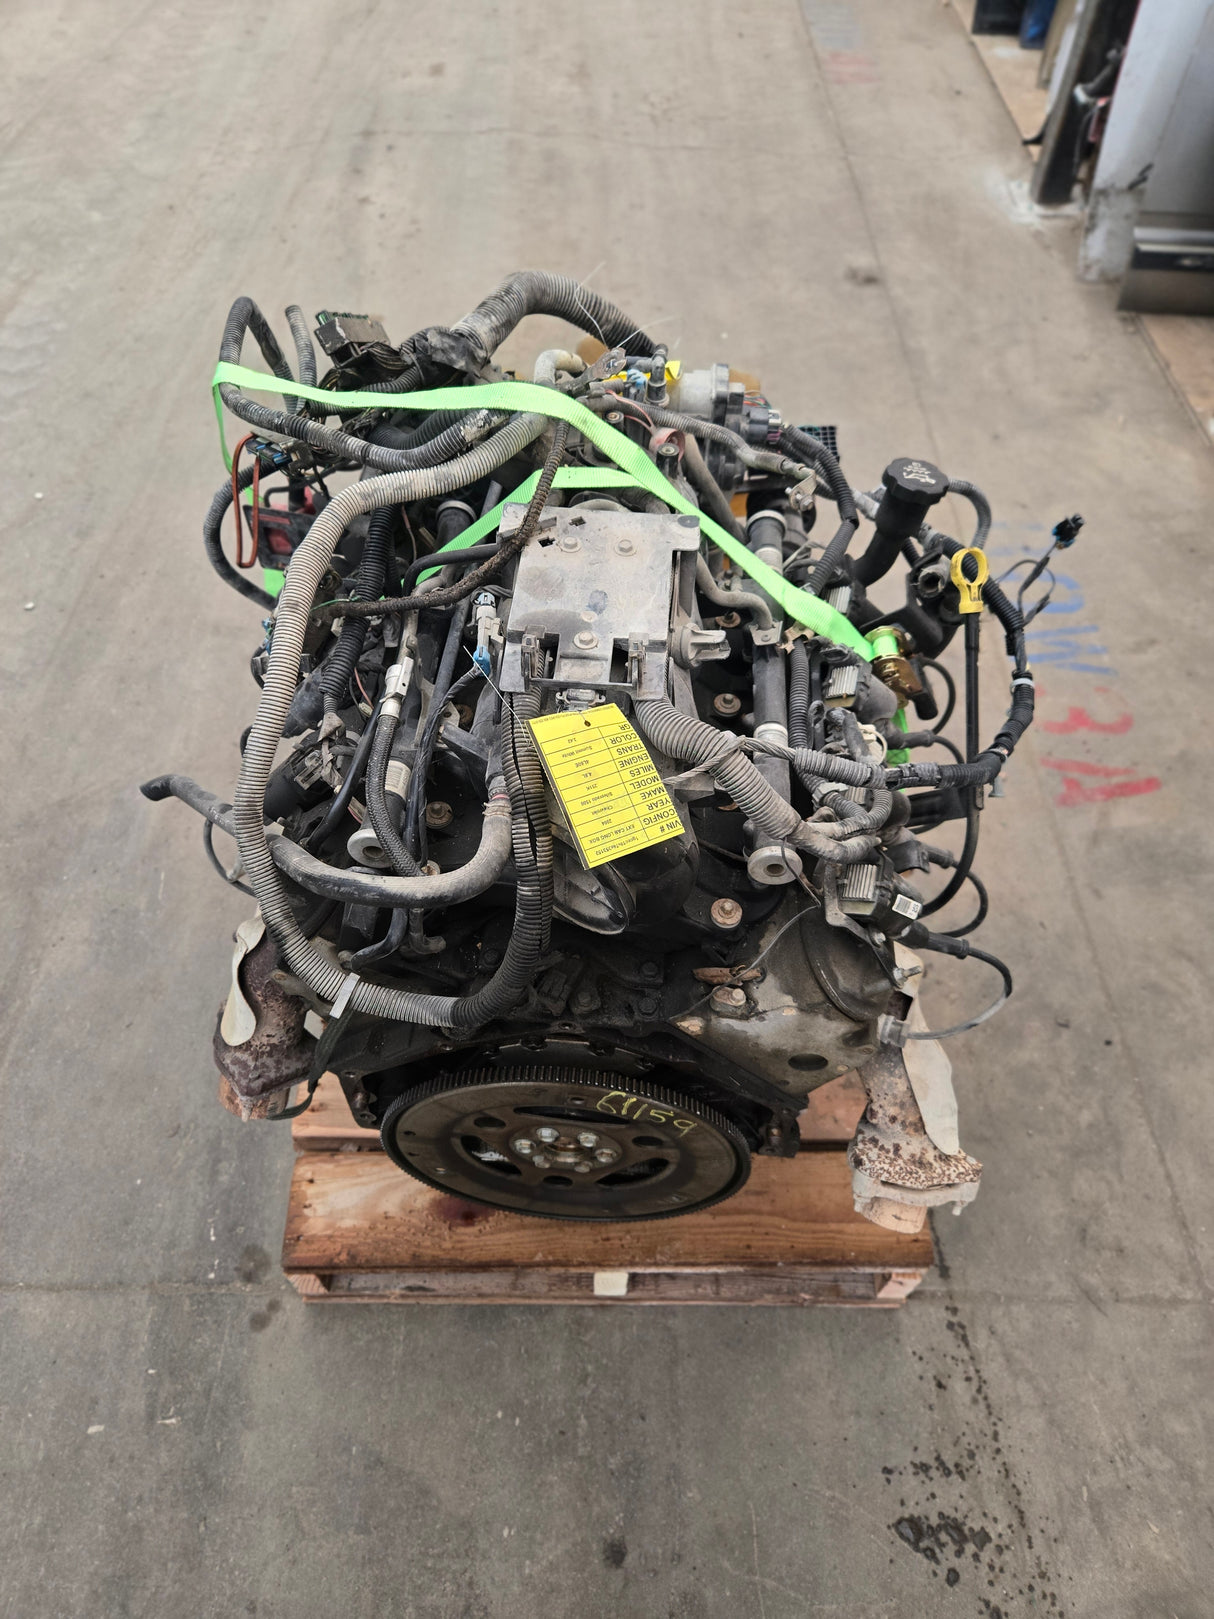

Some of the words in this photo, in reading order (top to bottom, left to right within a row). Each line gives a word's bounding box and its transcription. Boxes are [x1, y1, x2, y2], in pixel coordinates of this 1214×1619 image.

[620, 723, 631, 731] GR
[609, 732, 637, 745] COLOR
[616, 743, 644, 756] TRANS
[617, 753, 649, 769] ENGINE
[629, 764, 655, 778] MILES
[629, 775, 660, 790] MODEL
[640, 785, 665, 800] MAKE
[646, 797, 671, 811] YEAR
[643, 808, 676, 826] CONFIG
[659, 824, 666, 833] #
[666, 820, 682, 831] VIN
[600, 831, 614, 840] LONG
